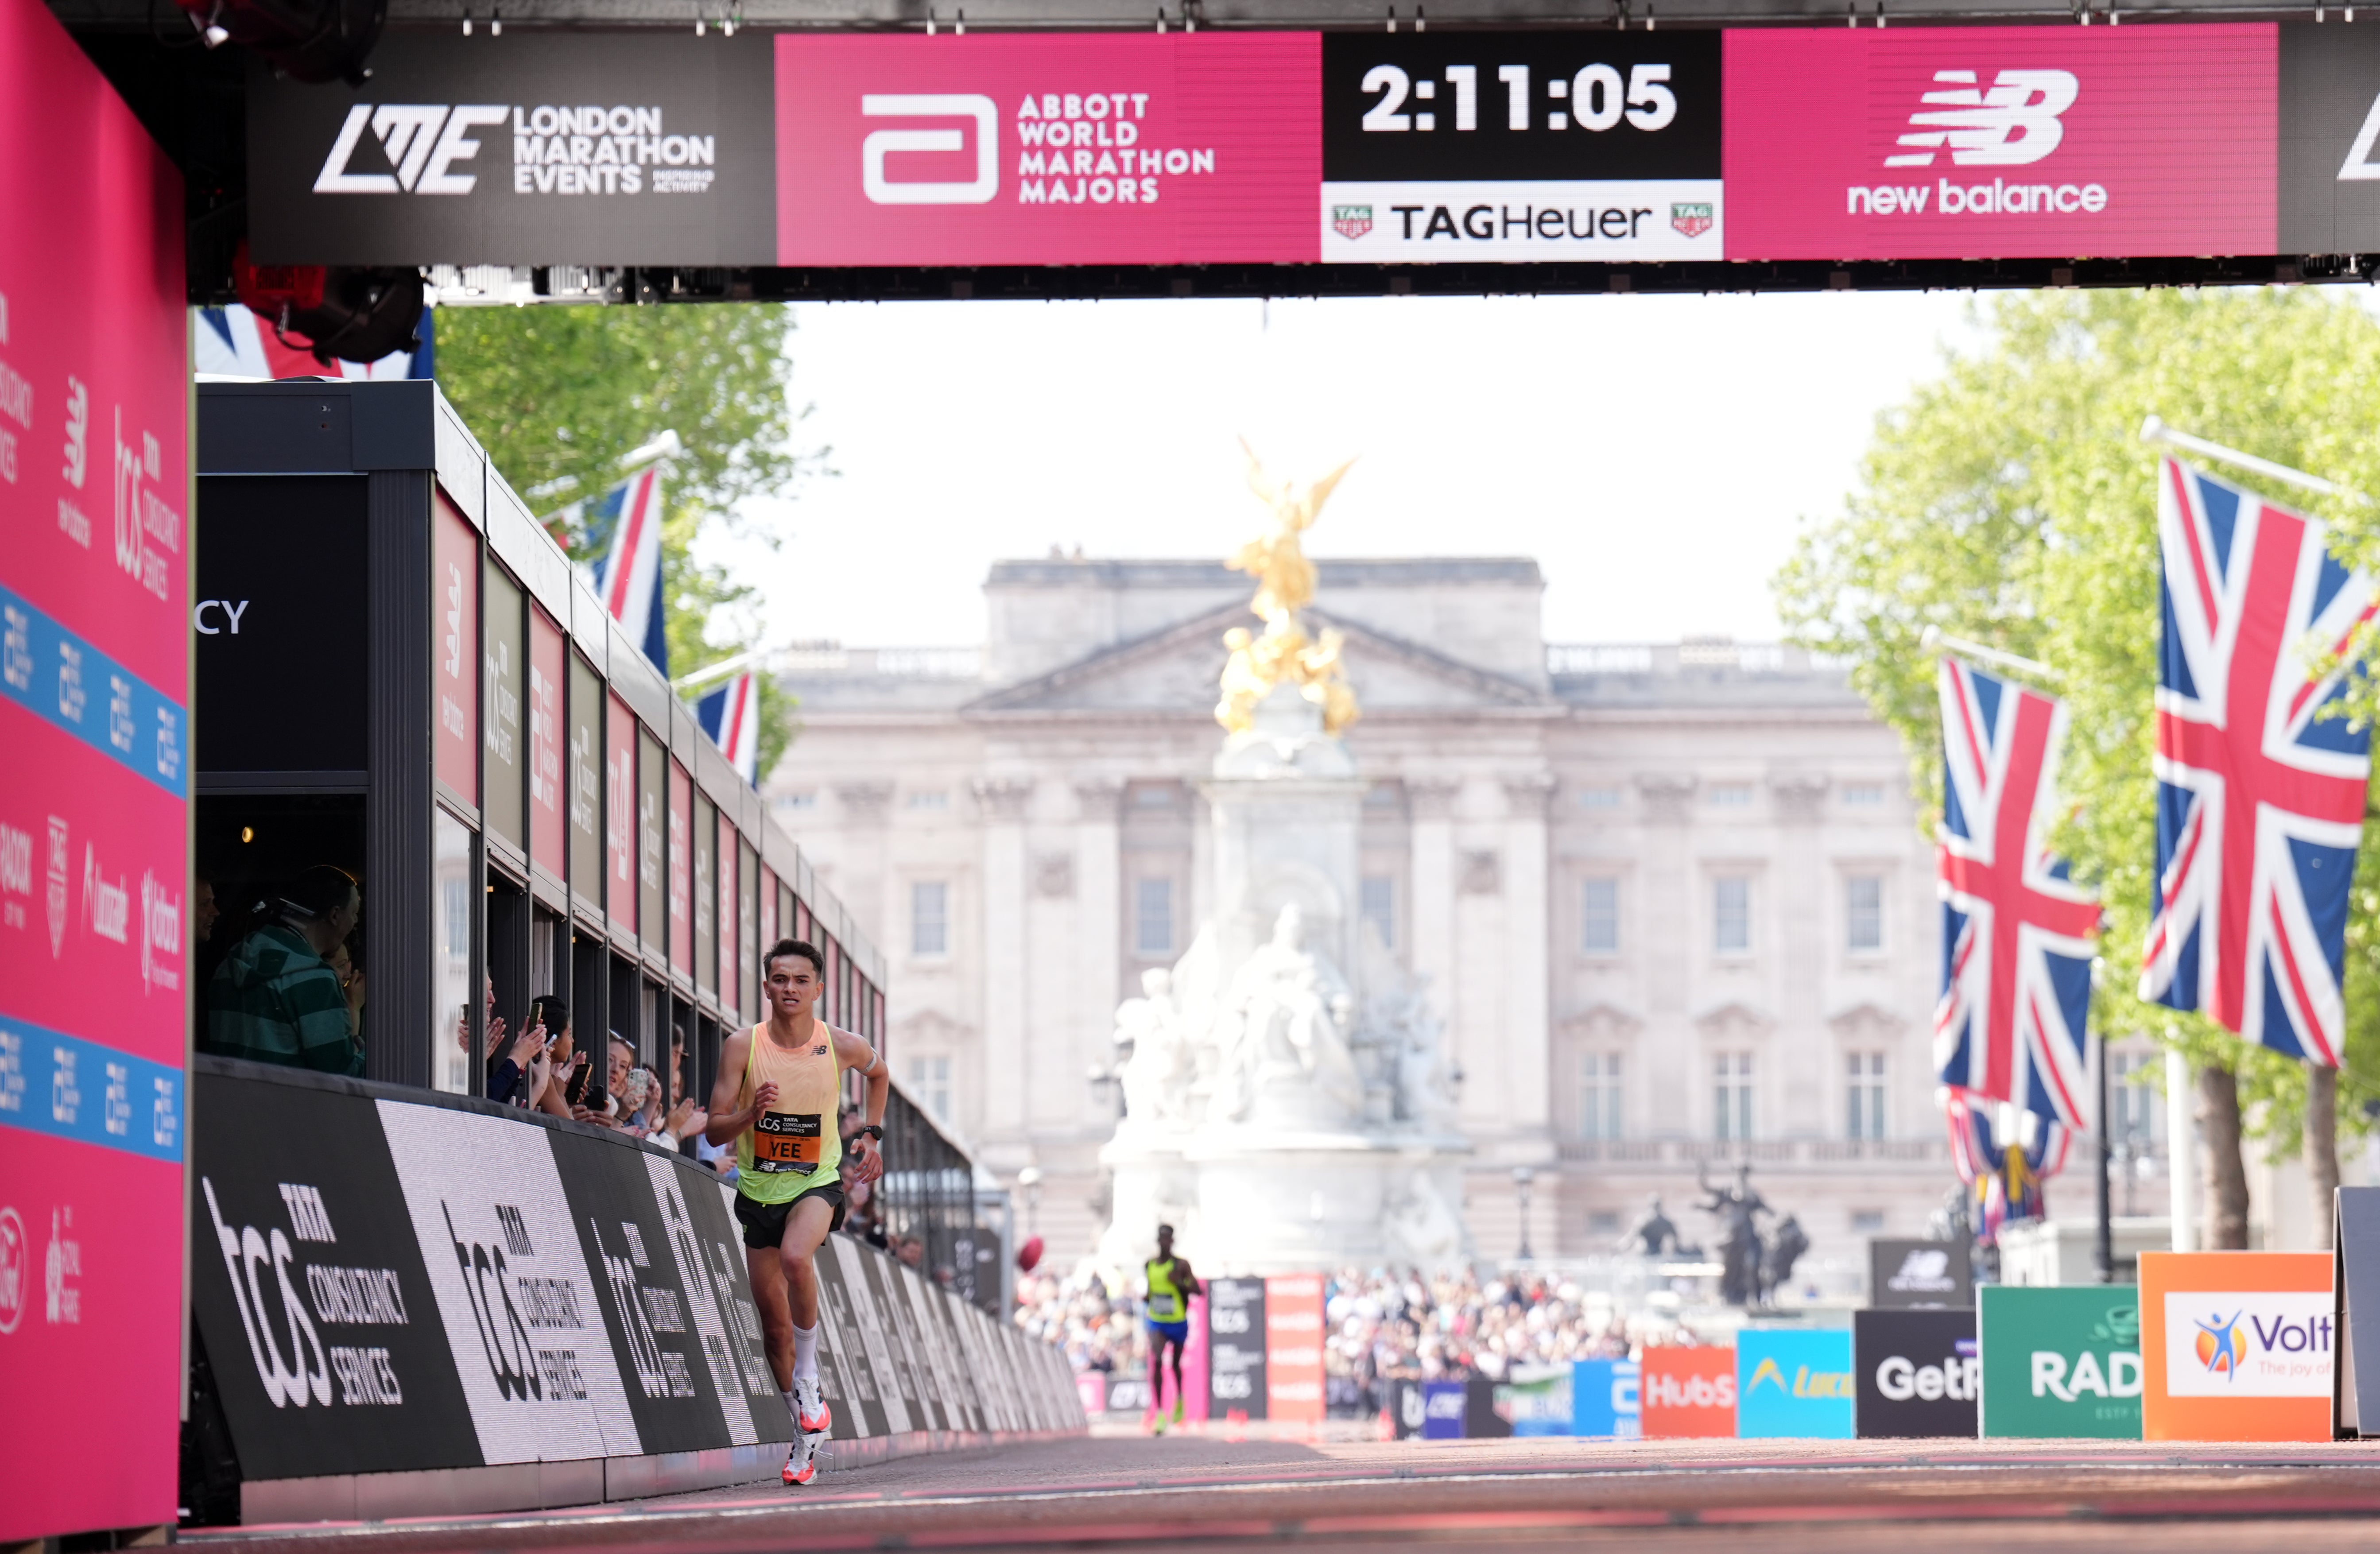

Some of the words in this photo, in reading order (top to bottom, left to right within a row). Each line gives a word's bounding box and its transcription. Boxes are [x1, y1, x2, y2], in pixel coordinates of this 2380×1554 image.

[1017, 93, 1149, 119] ABBOTT
[1361, 63, 1677, 132] 2:11:05
[514, 105, 663, 135] LONDON
[1017, 121, 1138, 147] WORLD
[514, 134, 715, 165] MARATHON
[1018, 148, 1215, 175] MARATHON
[515, 163, 642, 194] EVENTS
[1019, 178, 1159, 204] MAJORS
[1847, 185, 1930, 214] new
[1938, 178, 2108, 214] balance
[142, 489, 180, 554] CONSULTANCY
[142, 546, 168, 601] SERVICES
[770, 1141, 801, 1158] YEE
[278, 1182, 337, 1243] TATA
[202, 1176, 332, 1407] tcs
[306, 1263, 409, 1325] CONSULTANCY
[441, 1199, 542, 1401] tcs
[590, 1217, 669, 1398] tcs
[2251, 1314, 2332, 1352] Volt
[330, 1346, 403, 1405] SERVICES
[2031, 1351, 2143, 1402] RAD
[2259, 1360, 2286, 1375] The
[2290, 1360, 2314, 1380] joy
[2317, 1360, 2331, 1375] of
[1644, 1373, 1735, 1408] HubS
